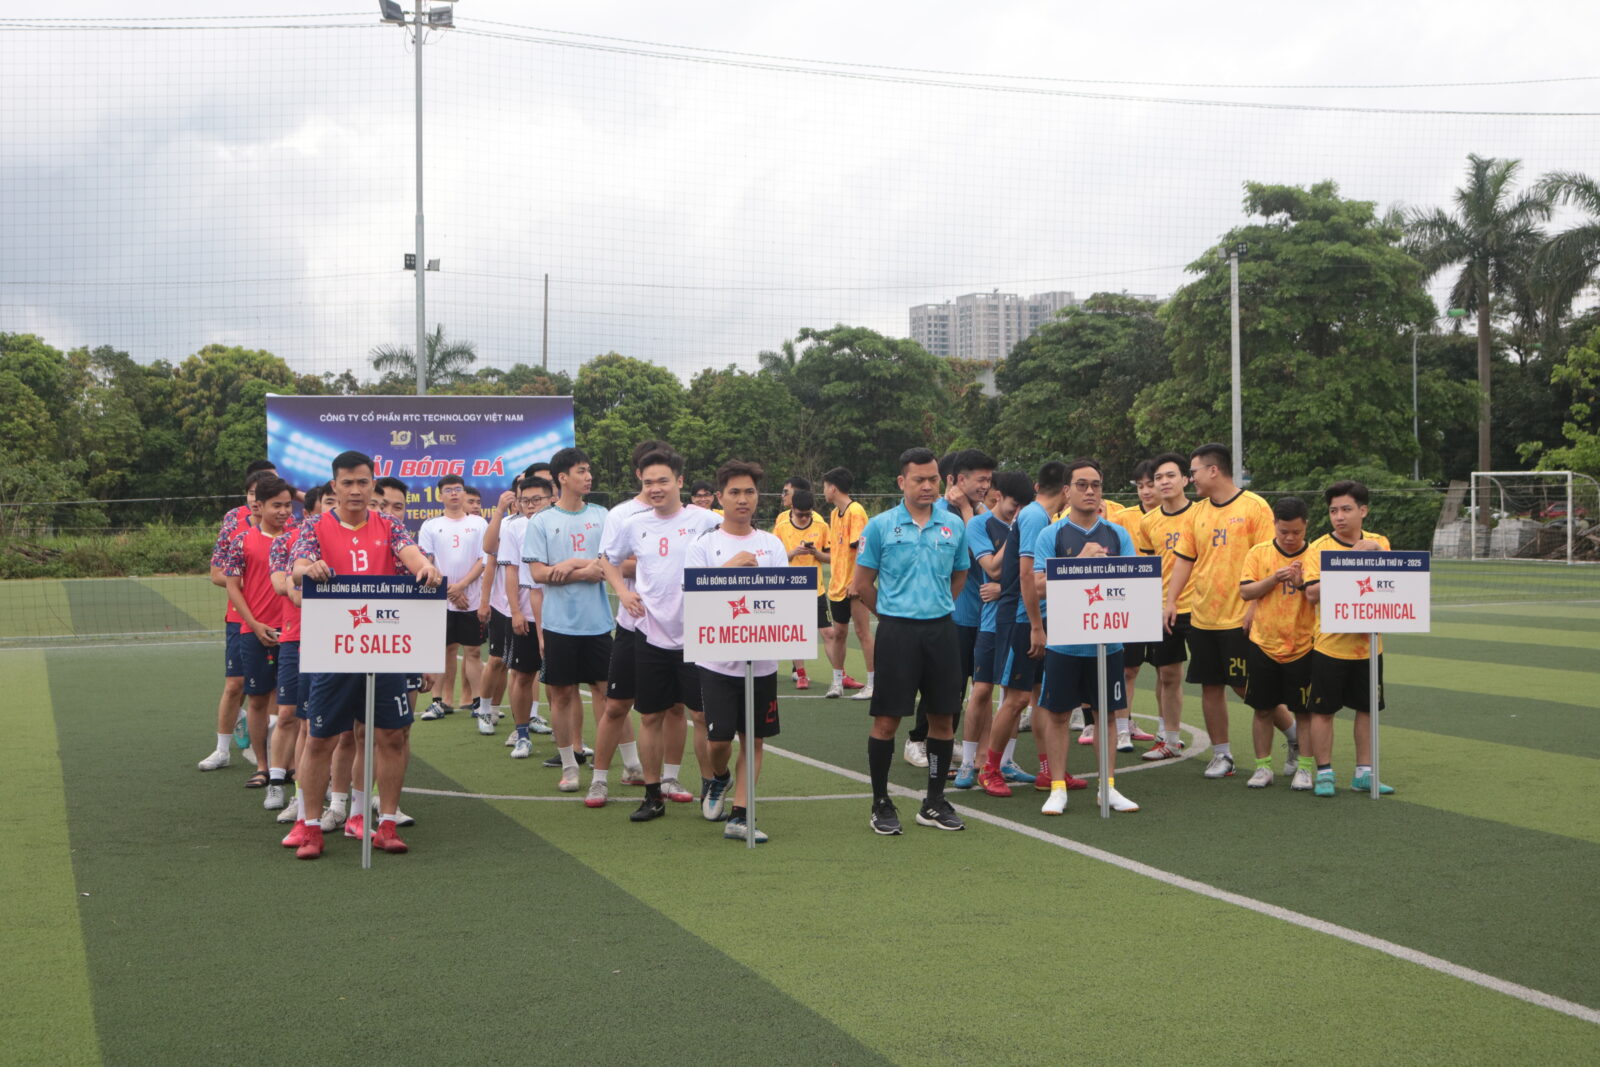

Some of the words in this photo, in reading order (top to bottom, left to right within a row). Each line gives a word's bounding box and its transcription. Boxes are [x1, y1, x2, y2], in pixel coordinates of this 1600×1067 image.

[320, 412, 345, 422] CÔNG
[361, 411, 374, 422] CỔ
[422, 414, 482, 422] TECHNOLOGY
[484, 412, 502, 423] VIỆT
[472, 456, 504, 476] ĐÁ
[452, 534, 460, 548] 3
[570, 534, 586, 552] 12
[1212, 528, 1227, 547] 24
[658, 537, 668, 556] 8
[350, 550, 368, 572] 13
[1342, 557, 1356, 566] BÓNG
[1356, 557, 1364, 566] ĐÁ
[1057, 565, 1067, 575] GIẢI
[1069, 565, 1083, 574] BÓNG
[1084, 565, 1092, 574] ĐÁ
[316, 582, 330, 593] GIẢI
[331, 582, 349, 593] BÓNG
[351, 582, 360, 593] ĐÁ
[362, 584, 375, 593] RTC
[406, 584, 413, 593] IV
[696, 576, 708, 585] GIẢI
[710, 575, 727, 585] BÓNG
[728, 575, 737, 585] ĐÁ
[738, 577, 750, 585] RTC
[778, 576, 785, 584] IV
[791, 576, 807, 584] 2025
[1377, 580, 1395, 588] RTC
[1106, 588, 1126, 597] RTC
[754, 600, 775, 609] RTC
[1335, 603, 1349, 619] FC
[1352, 603, 1416, 619] TECHNICAL
[376, 609, 400, 619] RTC
[1083, 612, 1098, 630] FC
[1104, 612, 1129, 629] AGV
[699, 626, 715, 644] FC
[720, 625, 807, 644] MECHANICAL
[335, 635, 354, 654] FC
[360, 635, 412, 654] SALES
[1229, 658, 1246, 676] 24
[394, 692, 408, 716] 13
